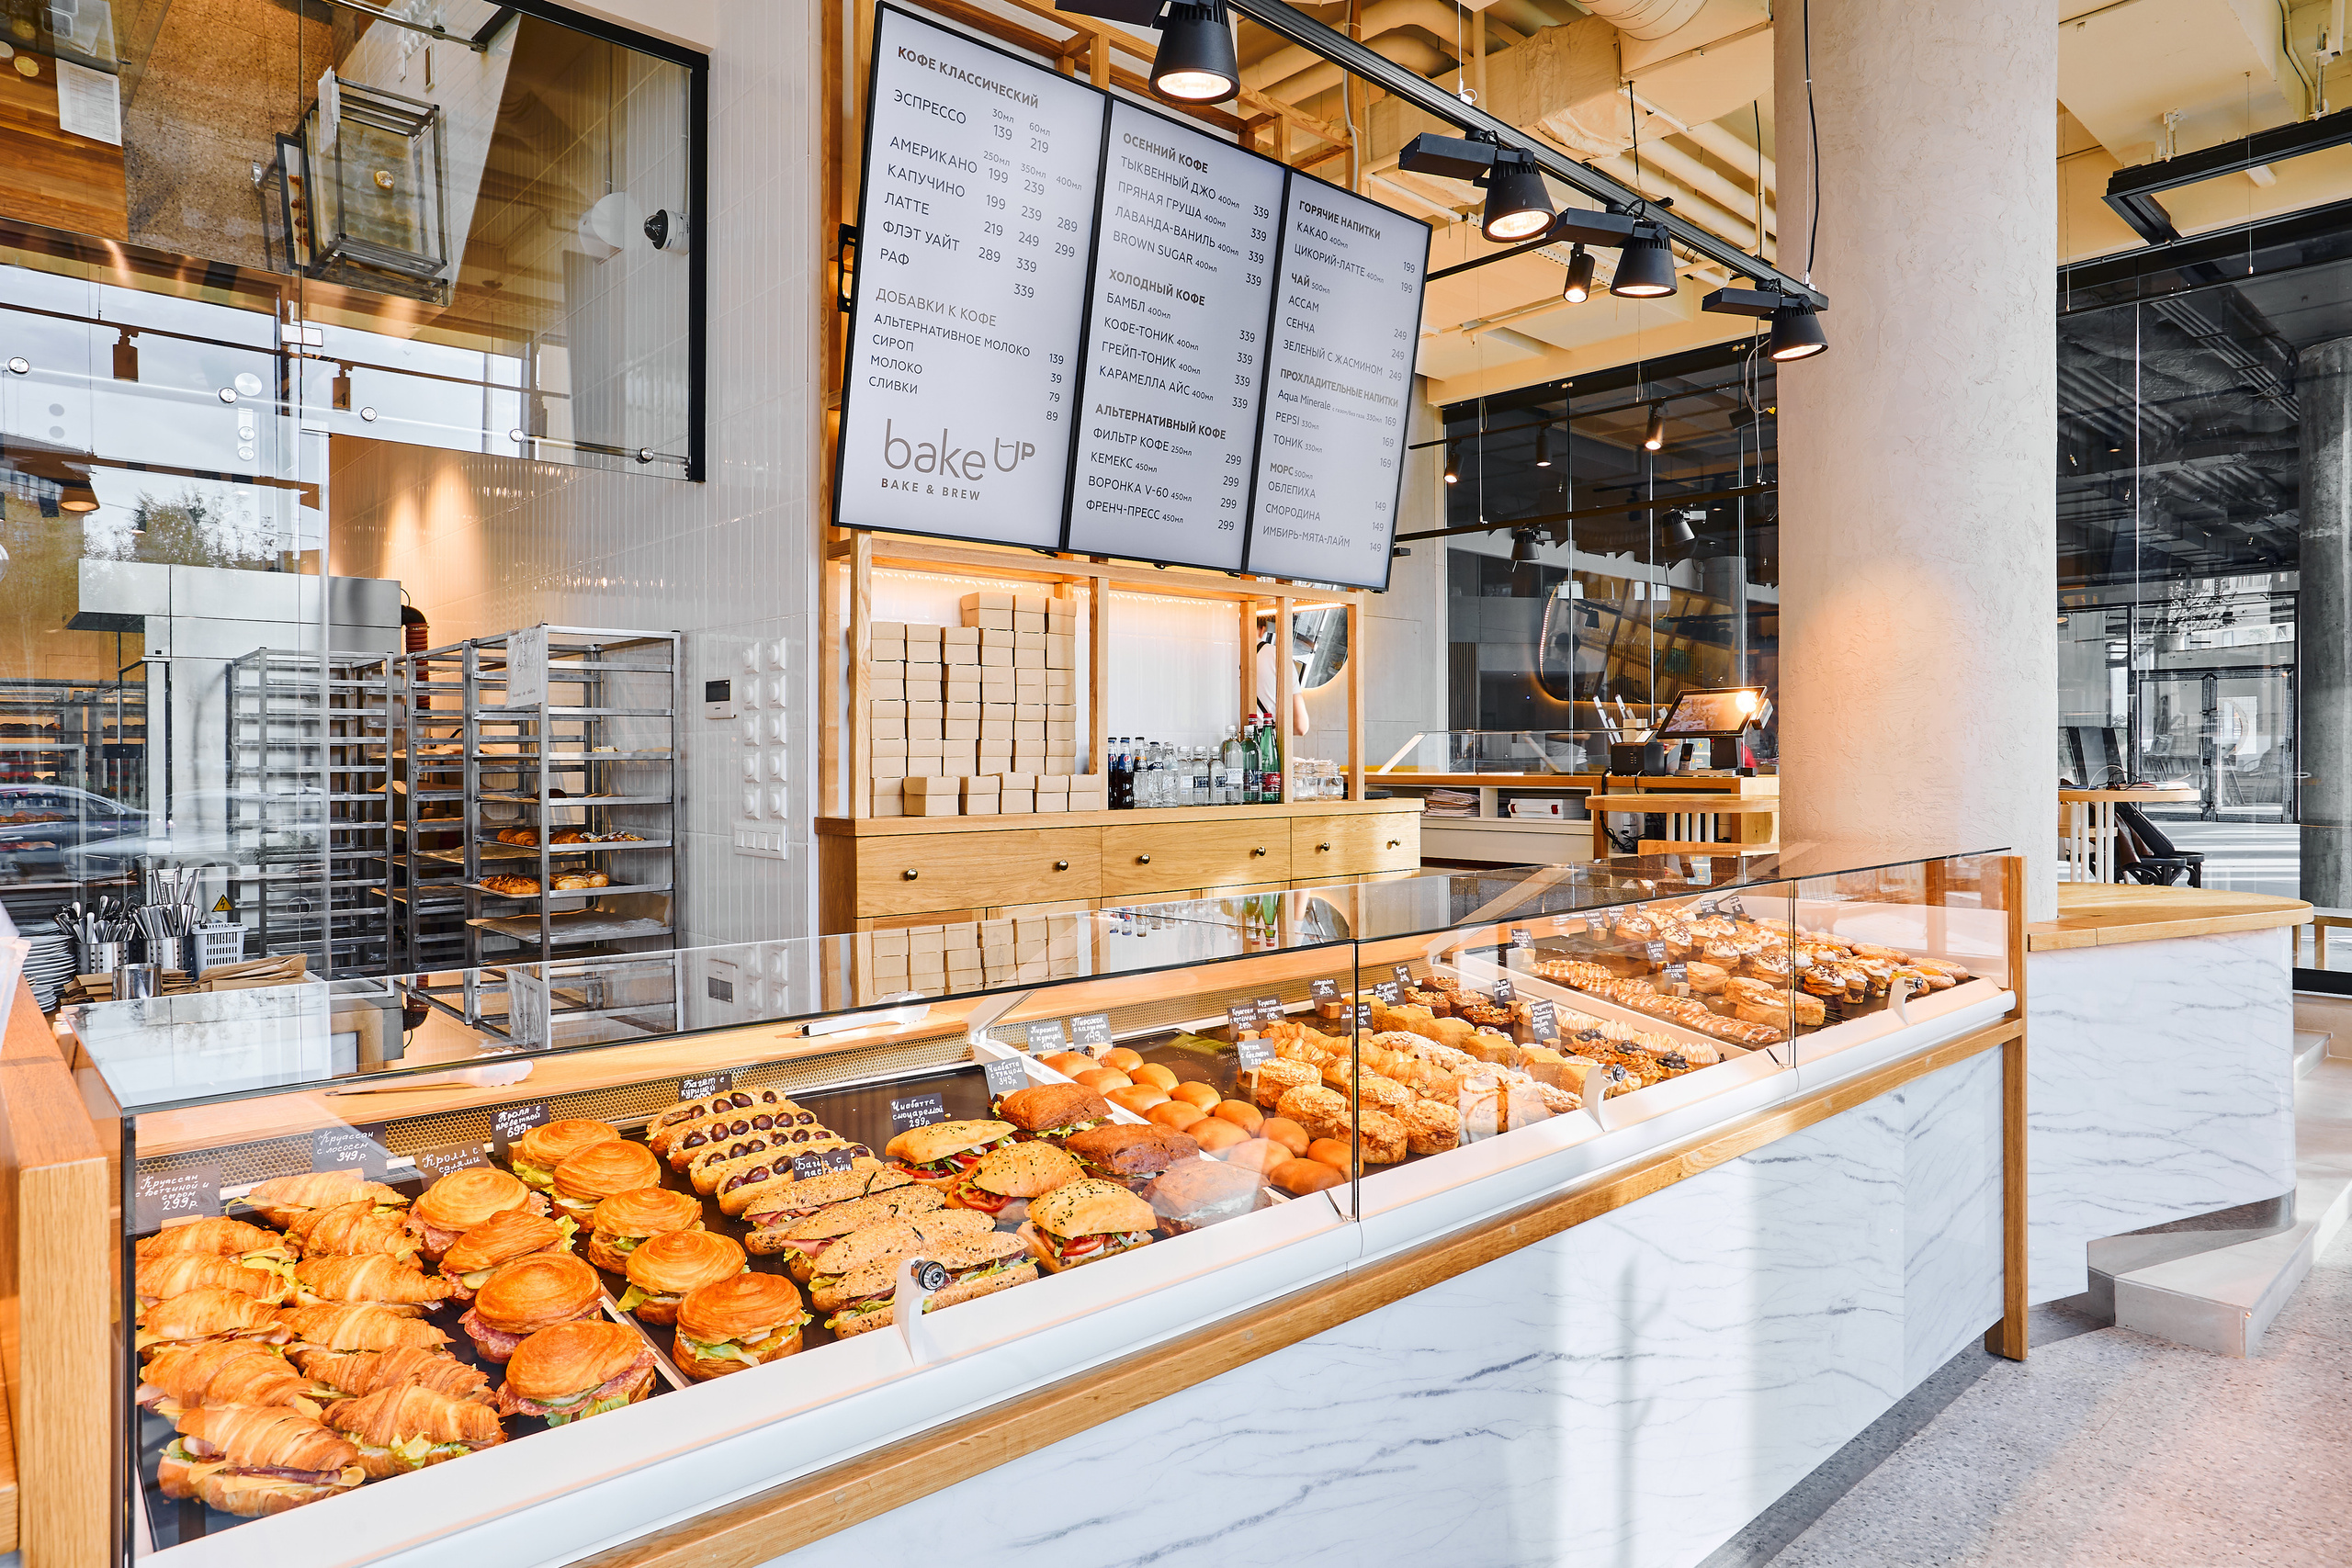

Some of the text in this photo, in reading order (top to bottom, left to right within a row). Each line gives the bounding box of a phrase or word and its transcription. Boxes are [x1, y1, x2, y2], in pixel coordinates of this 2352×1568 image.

[898, 45, 1038, 108] КОФЕ КЛАССИЧЕСКИЙ
[893, 88, 1049, 153] ЭСПРЕССО 139 219
[991, 107, 1051, 137] 30мл 60мл
[889, 135, 1045, 196] АМЕРИКАНО 199 239
[983, 150, 1082, 191] 250мл 350мл 400мл
[1123, 132, 1208, 174] ОСЕННИЙ КОФЕ
[888, 163, 1078, 232] КАПУЧИНО 199 239 289
[1121, 155, 1270, 220] ТЫКВЕННЫЙ ДЖО 400мл 339
[884, 191, 1075, 258] ЛАТТЕ 219 249 299
[1117, 180, 1267, 242] ПРЯНАЯ ГРУША 400мл 339
[1298, 199, 1381, 240] ГОРЯЧИЕ НАПИТКИ
[882, 220, 1037, 273] ФЛЭТ УАЙТ 289 339
[1114, 206, 1264, 265] ЛАВАНДА-ВАНИЛЬ 400мл 339
[1296, 220, 1329, 242] КАКАО
[1403, 261, 1416, 274] 199
[879, 247, 1035, 299] РАФ 339
[1113, 230, 1261, 287] BROWN SUGAR 400мл 339
[1294, 243, 1413, 294] ЦИКОРИЙ-ЛАТТЕ 199
[1108, 268, 1205, 306] ХОЛОДНЫЙ КОФЕ
[1291, 272, 1310, 288] ЧАЙ
[875, 288, 997, 327] ДОБАВКИ К КОФЕ
[1106, 291, 1255, 343] БАМБЛ 400мл 339
[1287, 294, 1408, 341] АССАМ 249
[872, 333, 1062, 384] СИРОП 39
[873, 312, 1064, 365] АЛЬТЕРНАТИВНОЕ МОЛОКО 139
[1103, 316, 1253, 365] КОФЕ-ТОНИК 400мл 339
[1285, 316, 1405, 361] СЕНЧА 249
[870, 354, 1060, 403] МОЛОКО 79
[1102, 340, 1250, 388] ГРЕЙП-ТОНИК 400мл 339
[1283, 338, 1402, 381] ЗЕЛЕНЫЙ С ЖАСМИНОМ 249
[868, 376, 1058, 422] СЛИВКИ 89
[1099, 365, 1249, 409] КАРАМЕЛЛА АЙС 400мл 339
[1279, 367, 1398, 408] ПРОХЛАДИТЕЛЬНЫЕ НАПИТКИ
[1095, 403, 1227, 440] АЛЬТЕРНАТИВНЫЙ КОФЕ
[1277, 389, 1396, 427] Aqua Minerale 169
[884, 417, 986, 481] bake
[1092, 427, 1242, 466] ФИЛЬТР КОФЕ 250мл 299
[1274, 411, 1395, 447] PEPSI 169
[1091, 451, 1239, 488] КЕМЕКС 450мл 299
[1269, 462, 1294, 476] МОРС
[1272, 433, 1392, 468] ТОНИК 169
[880, 477, 980, 501] BAKE & BREW
[1088, 475, 1237, 510] ВОРОНКА V-60 450мл 299
[1267, 480, 1386, 512] ОБЛЕПИХА 149
[1085, 499, 1235, 531] ФРЕНЧ-ПРЕСС 450мл 299
[1265, 502, 1385, 532] СМОРОДИНА 149
[1262, 525, 1382, 552] ИМБИРЬ-МЯТА-ЛАЙМ 149
[891, 1099, 935, 1111] Чиабатта
[317, 1130, 374, 1146] Круассан
[325, 1142, 369, 1154] лососем
[422, 1149, 468, 1168] Кролл
[140, 1175, 198, 1190] Круассан
[144, 1180, 199, 1198] ветчиной
[162, 1190, 197, 1201] сыром
